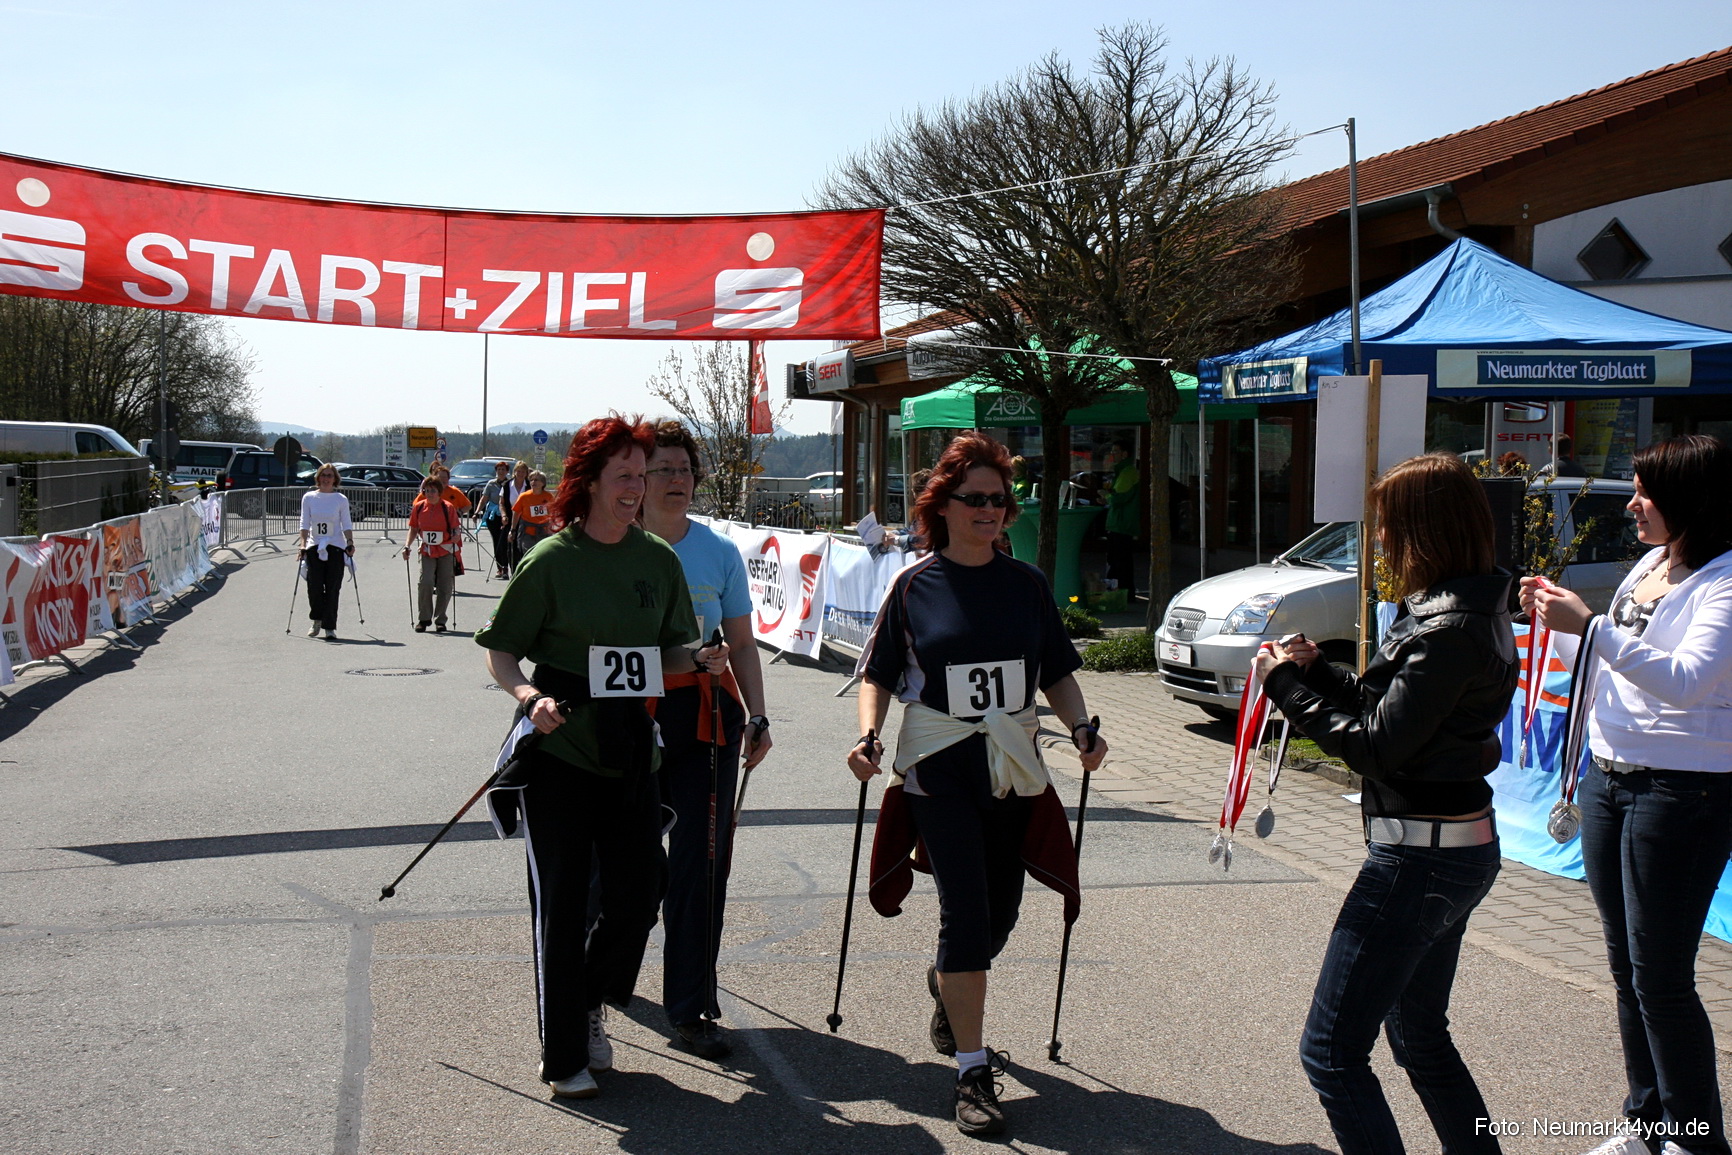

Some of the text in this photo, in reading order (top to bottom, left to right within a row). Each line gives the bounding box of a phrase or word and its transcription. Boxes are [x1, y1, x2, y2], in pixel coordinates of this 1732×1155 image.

[818, 362, 843, 380] SEAT
[1487, 360, 1648, 381] Neumarkter Tagblatt
[986, 394, 1036, 416] AOK
[1497, 433, 1554, 442] SEAT
[317, 522, 328, 535] 13
[426, 532, 437, 544] 12
[789, 629, 817, 643] AT
[604, 650, 647, 692] 29
[968, 666, 1006, 711] 31
